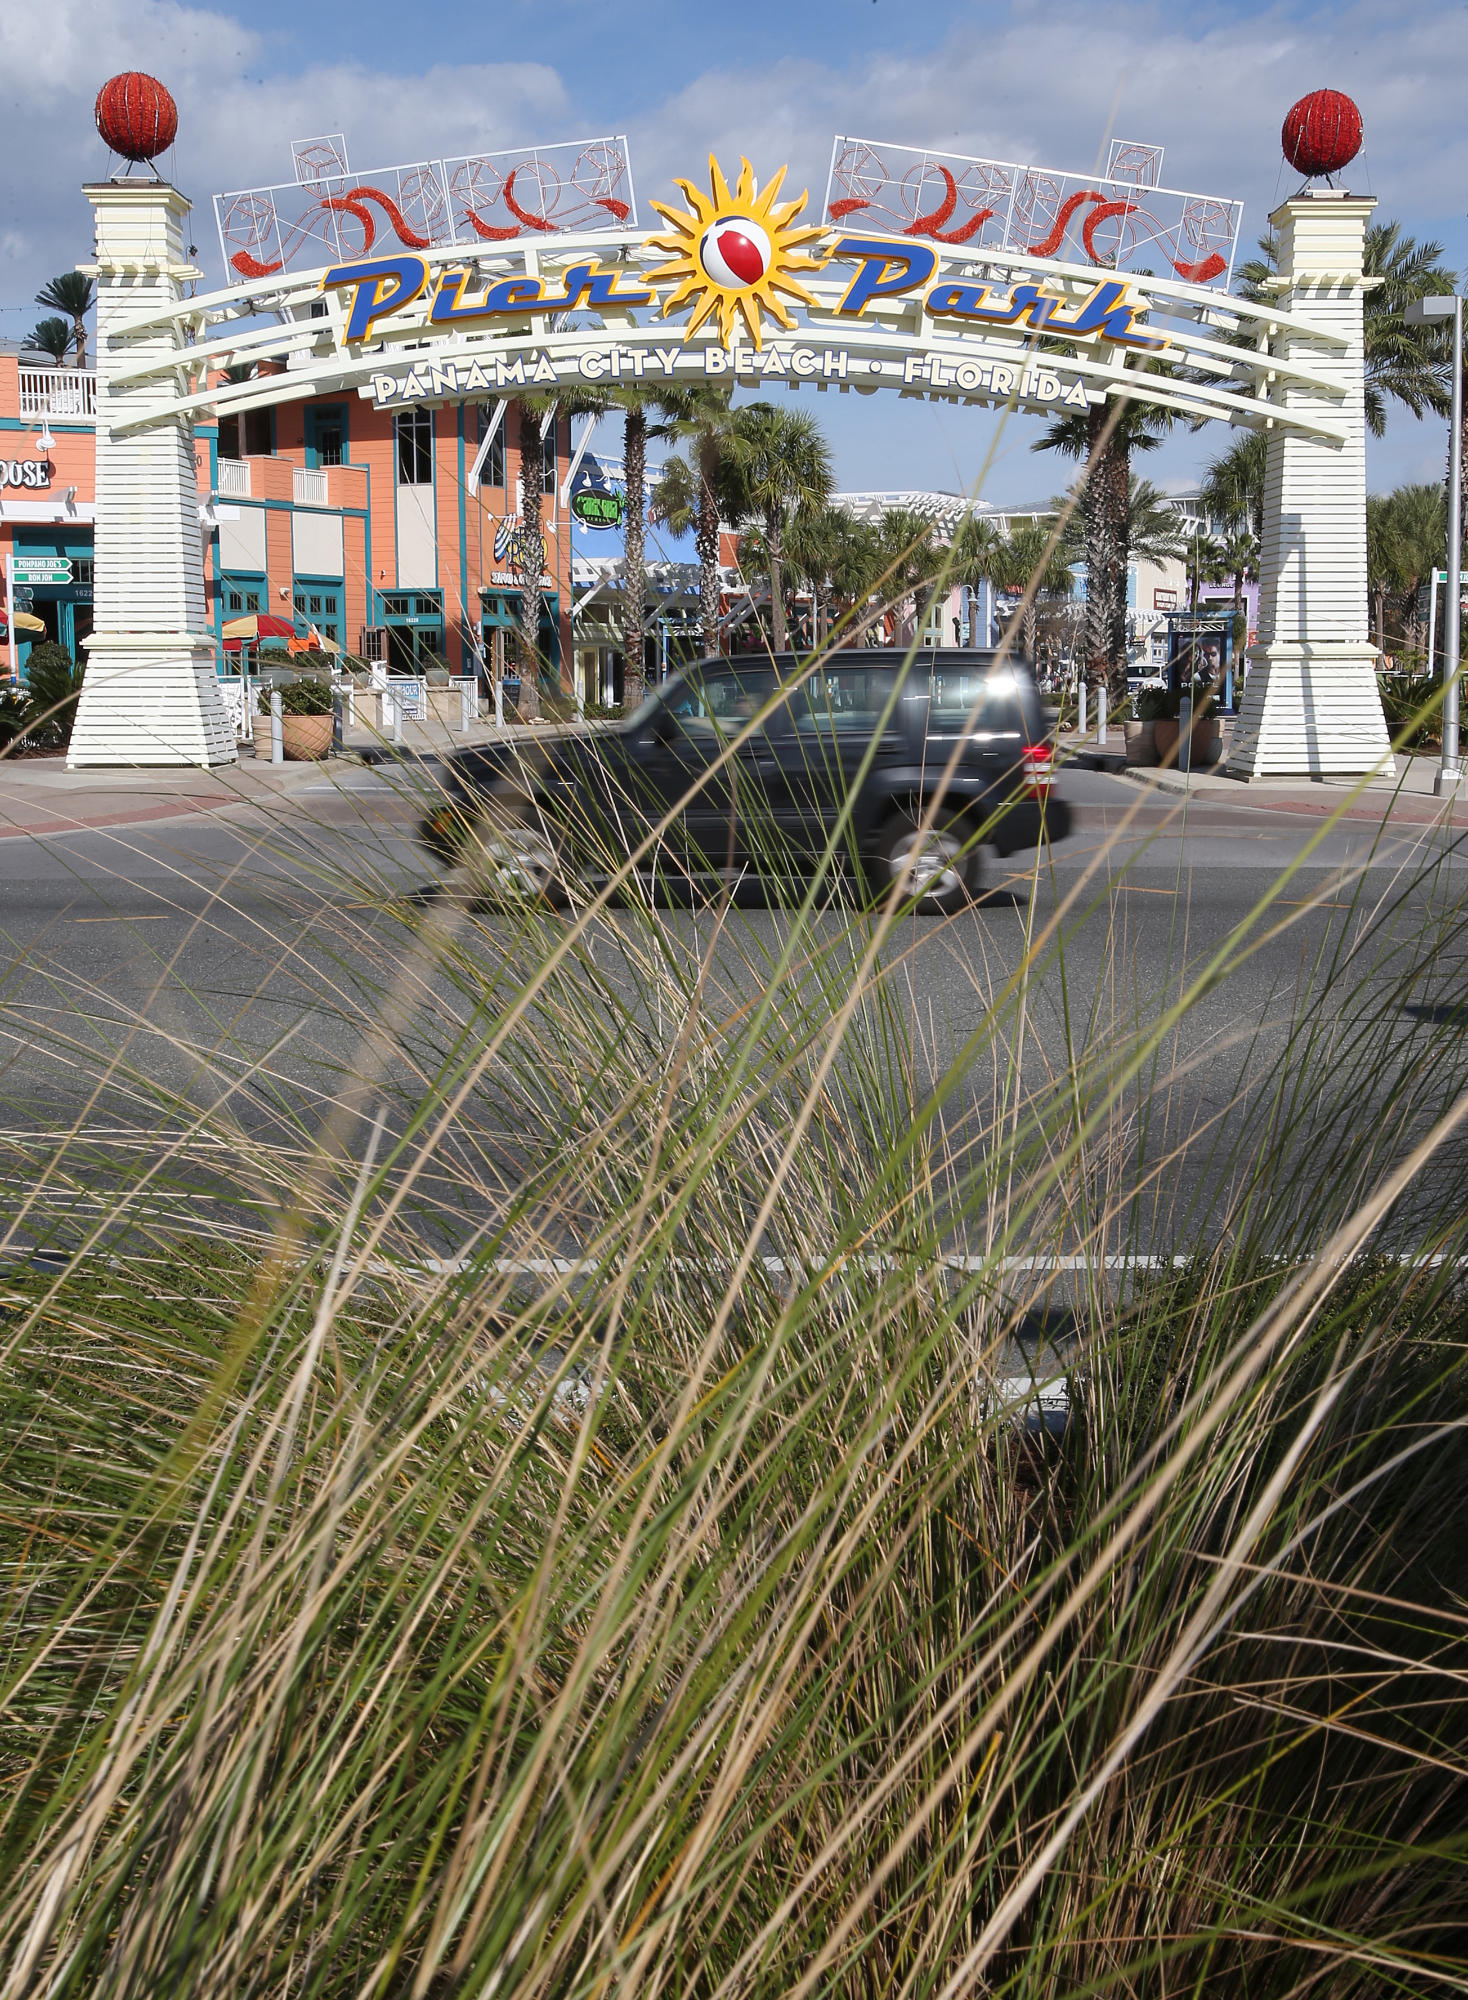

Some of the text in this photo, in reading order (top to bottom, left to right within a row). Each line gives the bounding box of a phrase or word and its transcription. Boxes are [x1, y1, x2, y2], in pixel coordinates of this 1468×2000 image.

[317, 234, 1172, 350] Pier Park
[373, 344, 1089, 409] PANAMA CITY BEACH FLORIDA
[18, 560, 46, 569] POMPANO
[28, 573, 53, 582] RON JON
